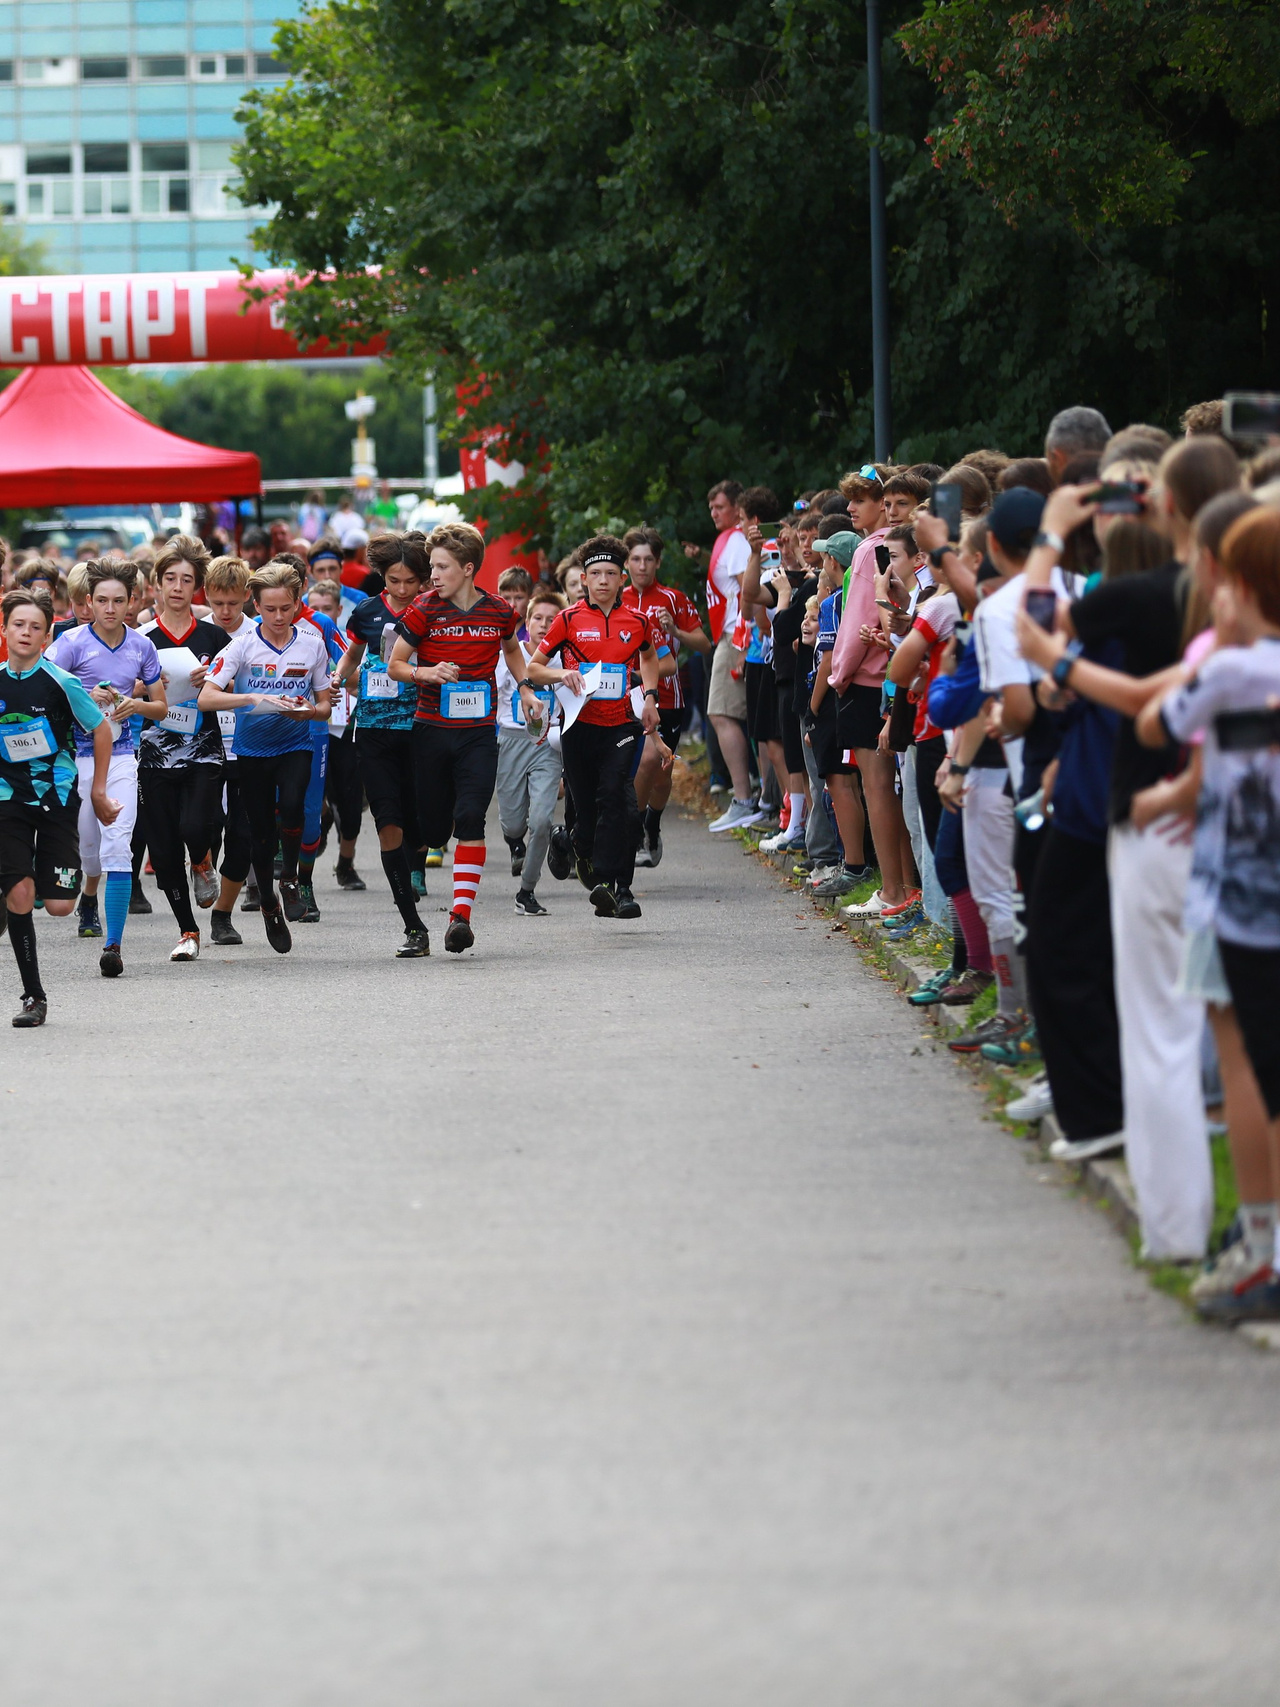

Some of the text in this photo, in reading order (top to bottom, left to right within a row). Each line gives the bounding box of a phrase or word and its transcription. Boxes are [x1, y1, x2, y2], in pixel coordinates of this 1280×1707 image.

[468, 626, 501, 637] WEST
[248, 679, 306, 689] KUZMOLOVO
[455, 697, 477, 706] 300.1
[166, 711, 189, 722] 302.1
[220, 716, 236, 724] 12.1
[11, 737, 37, 748] 306.1
